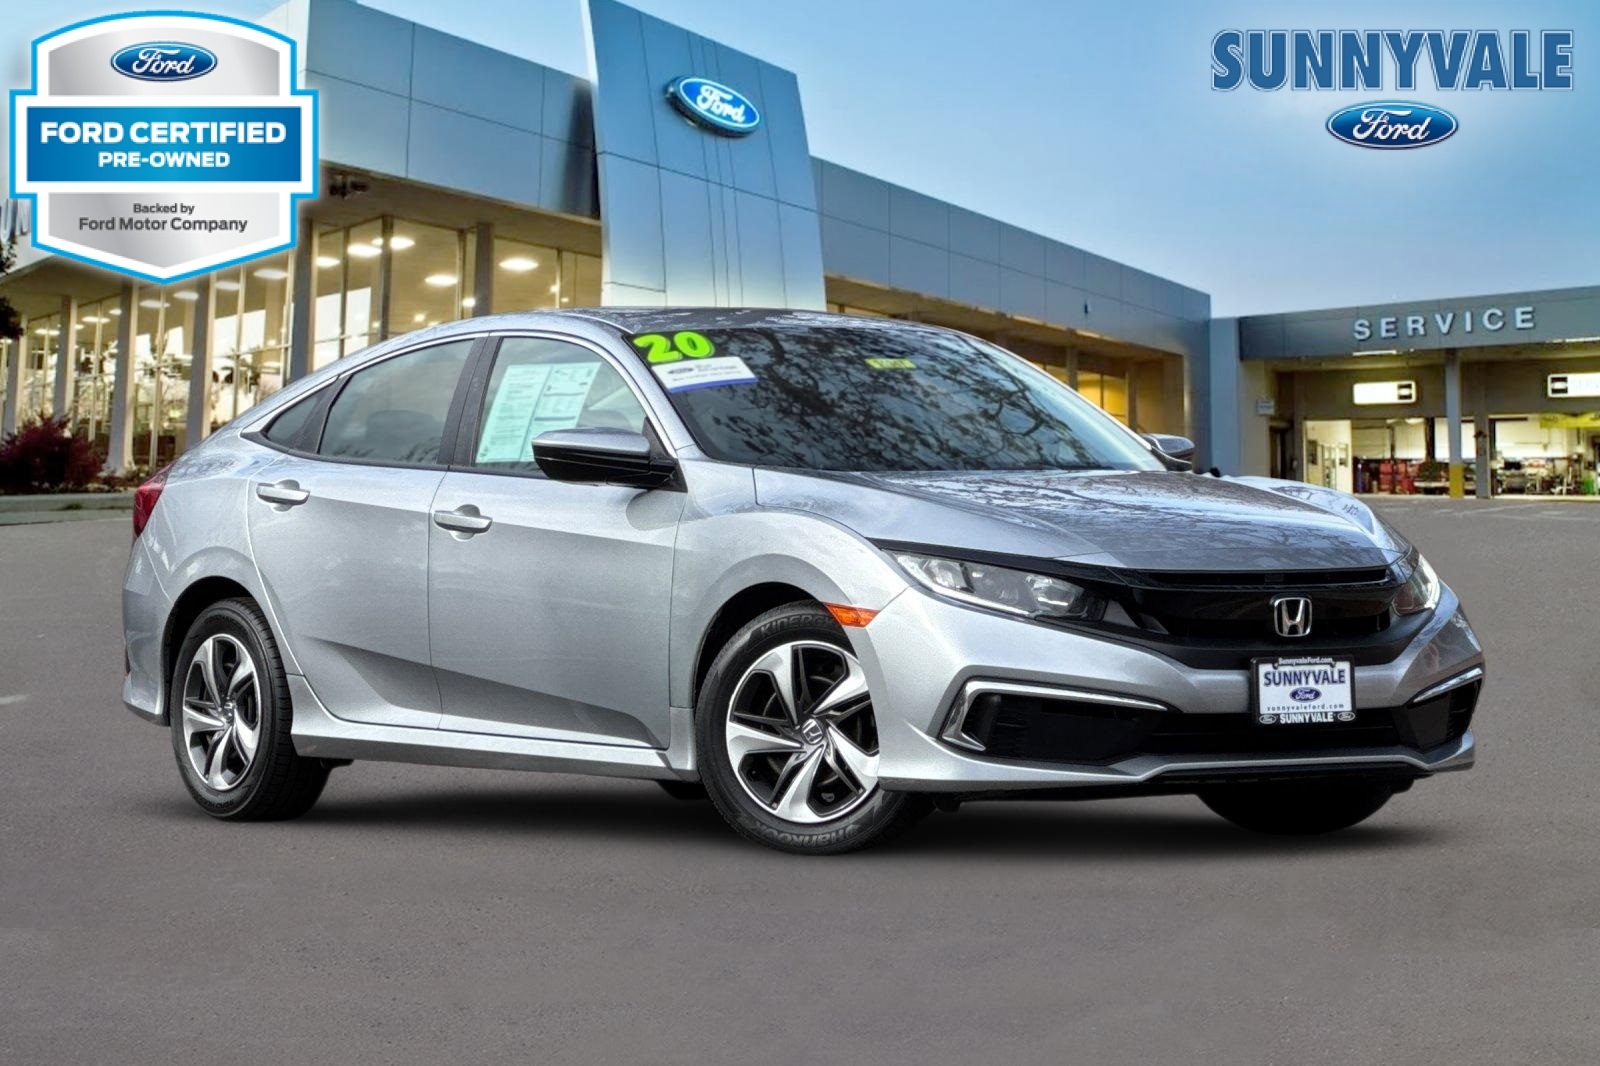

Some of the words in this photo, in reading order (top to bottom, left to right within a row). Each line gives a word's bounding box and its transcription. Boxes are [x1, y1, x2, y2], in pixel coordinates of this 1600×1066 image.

[696, 84, 746, 123] Ford
[1353, 306, 1536, 341] SERVICE
[633, 331, 715, 362] 20
[1264, 669, 1345, 687] SUNNYVALE
[1280, 712, 1334, 724] SUNNYVALE
